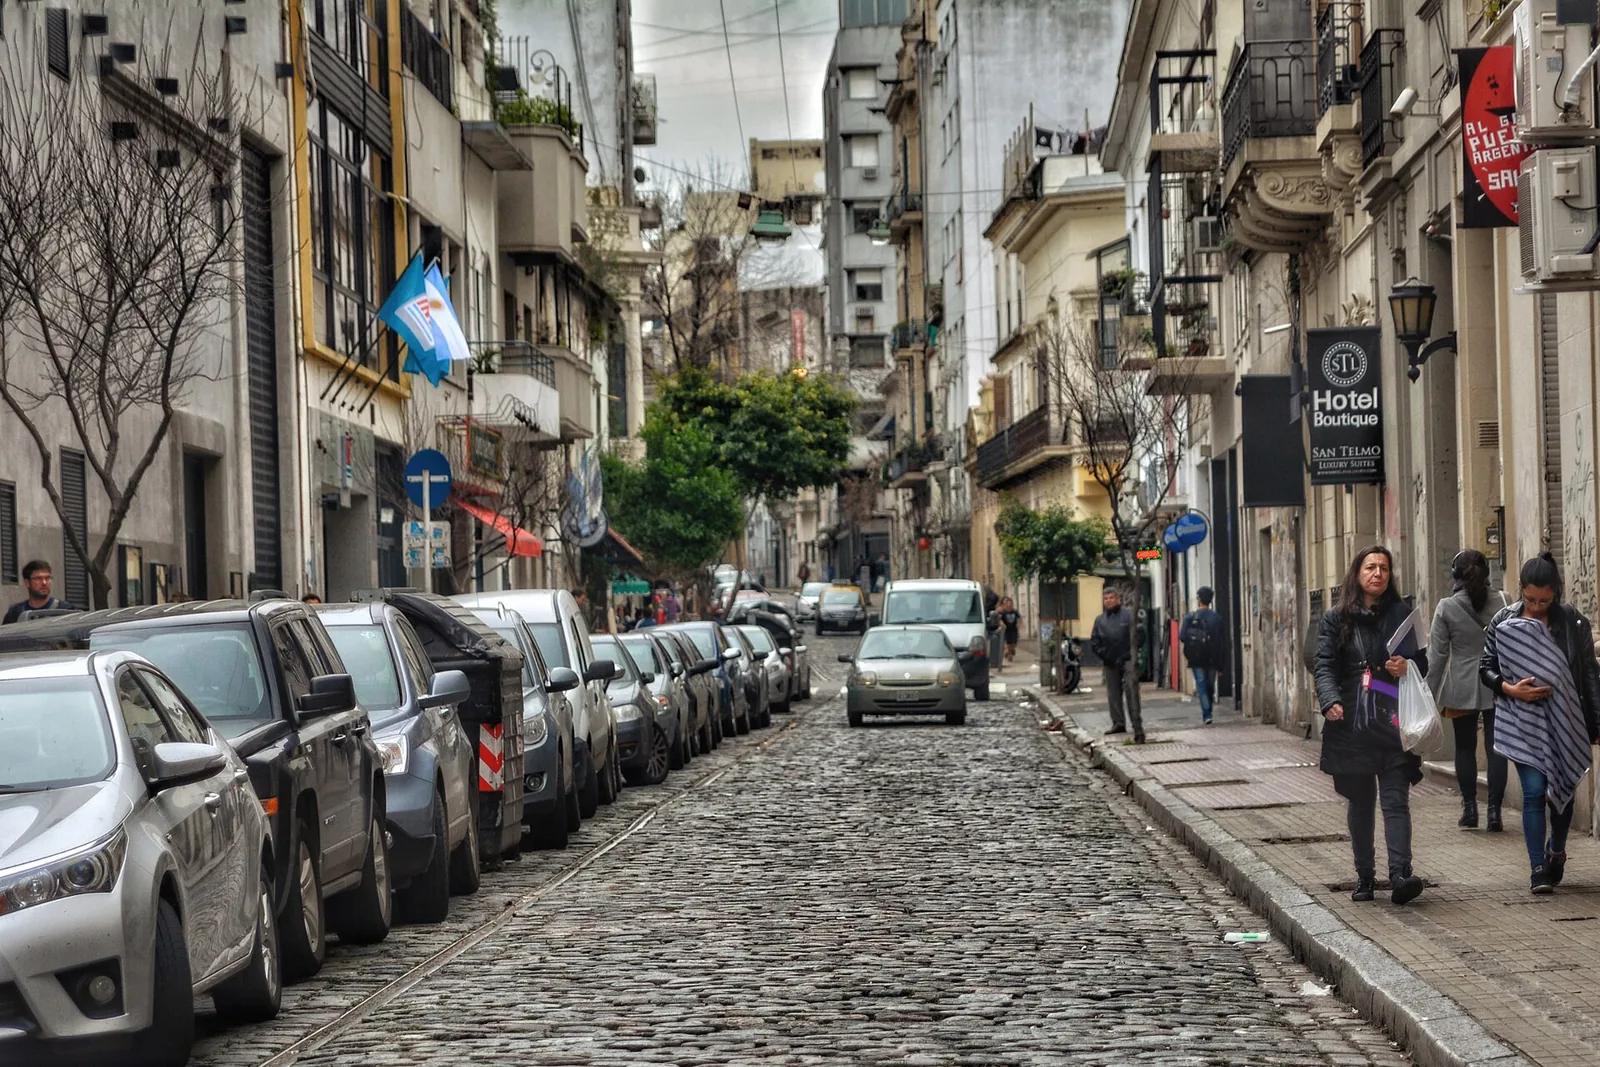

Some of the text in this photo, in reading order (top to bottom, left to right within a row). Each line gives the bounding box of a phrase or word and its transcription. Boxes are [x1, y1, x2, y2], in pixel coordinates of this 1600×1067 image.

[1466, 121, 1488, 136] AL
[1332, 353, 1359, 373] STL
[1313, 387, 1378, 411] Hotel
[1314, 411, 1378, 428] Boutique
[1312, 445, 1381, 458] SAN TELMO
[1318, 460, 1375, 470] LUXURY SUITES
